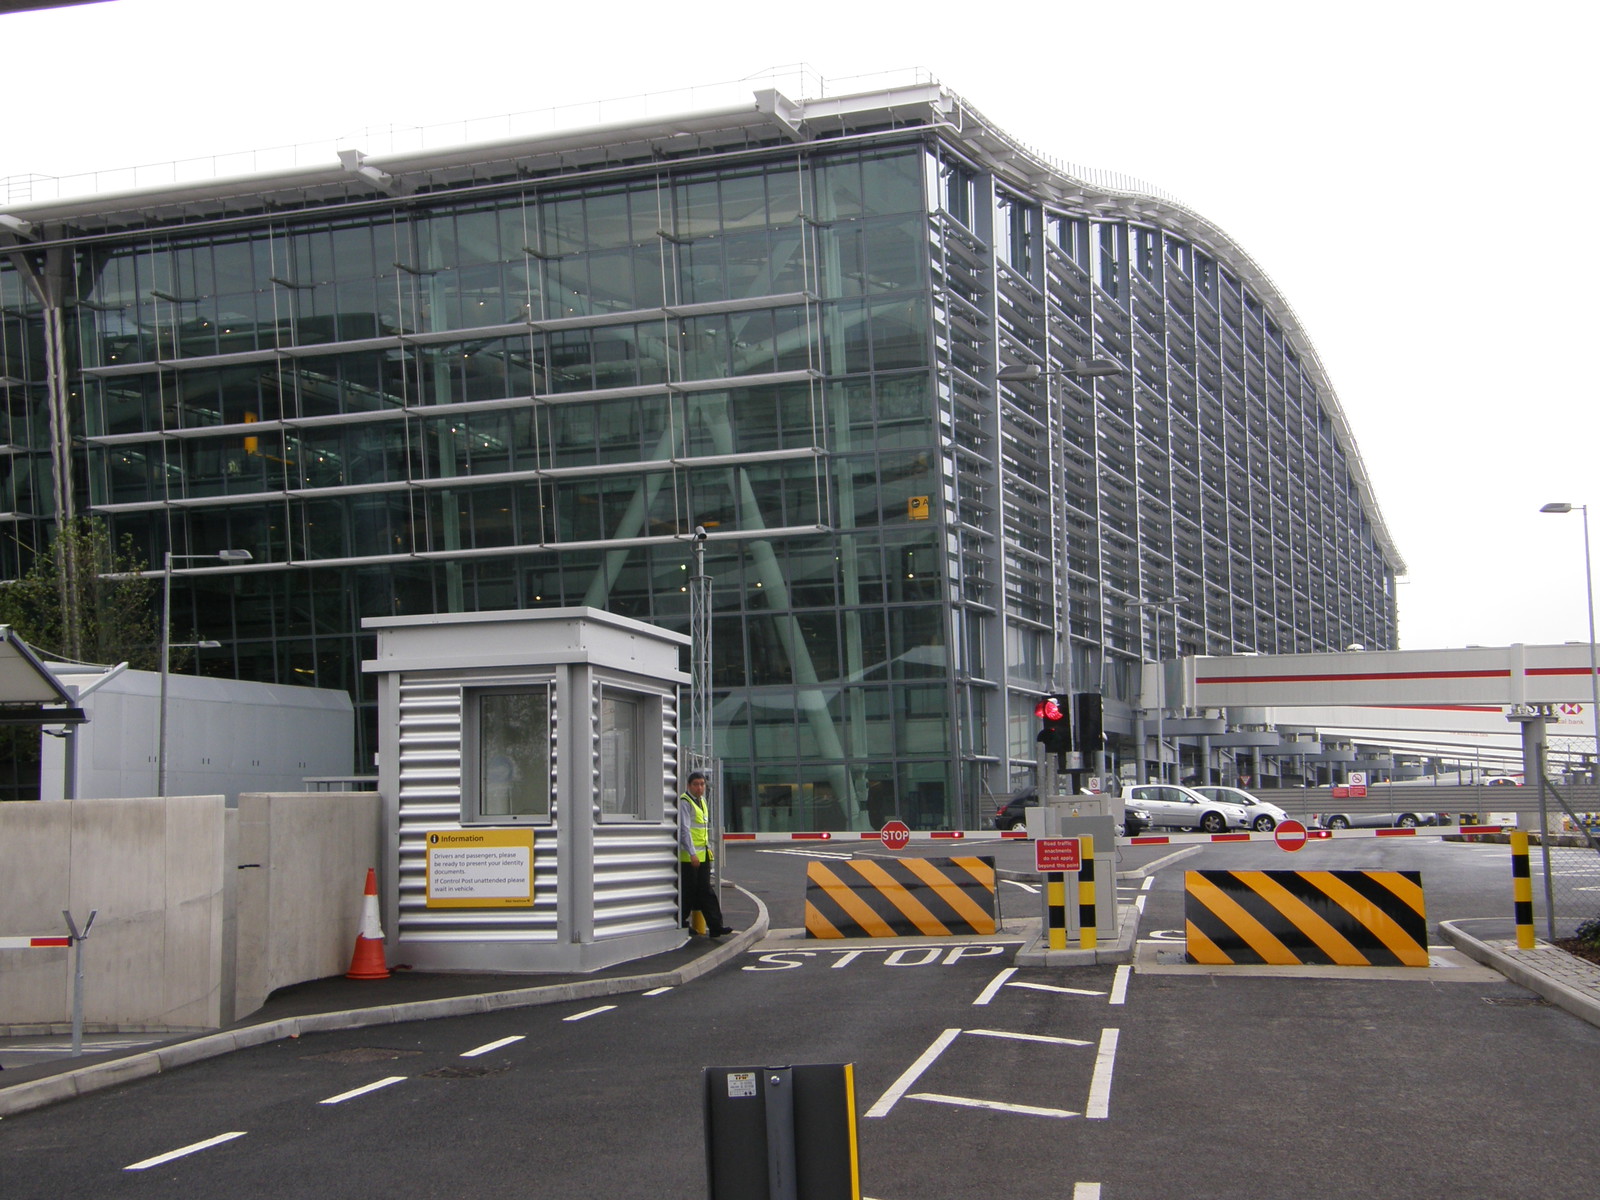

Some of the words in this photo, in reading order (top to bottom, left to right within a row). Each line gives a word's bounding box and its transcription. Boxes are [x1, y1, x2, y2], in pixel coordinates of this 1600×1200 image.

[882, 830, 908, 840] STOP
[466, 852, 498, 860] passengers,
[741, 945, 1004, 971] STOP
